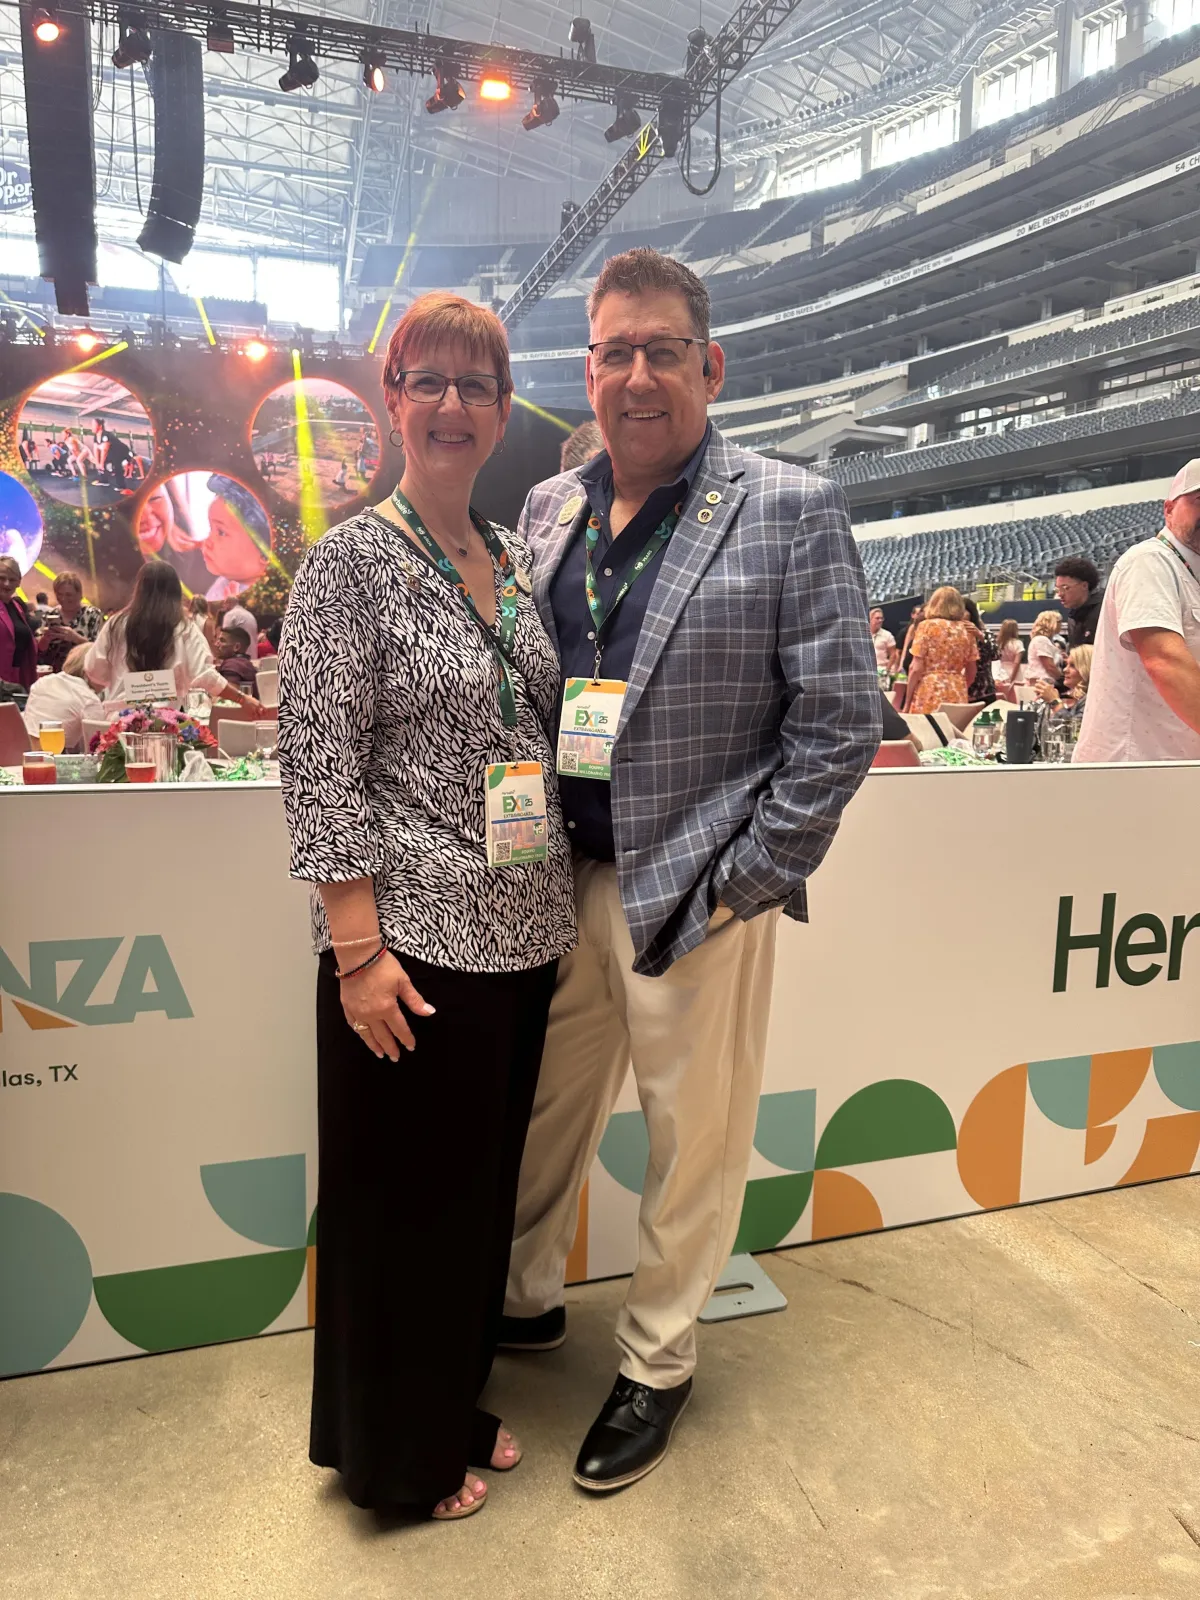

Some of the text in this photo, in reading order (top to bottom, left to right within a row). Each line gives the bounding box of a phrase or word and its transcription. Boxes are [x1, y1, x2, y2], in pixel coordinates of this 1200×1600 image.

[1174, 161, 1186, 173] 54
[1016, 228, 1026, 237] 20
[1028, 222, 1041, 232] MEL
[1042, 209, 1070, 226] RENFRO
[574, 709, 609, 728] EXT 25
[573, 726, 607, 734] EXTRAVAGANZA
[502, 794, 534, 814] EXT 25
[49, 1063, 79, 1083] TX
